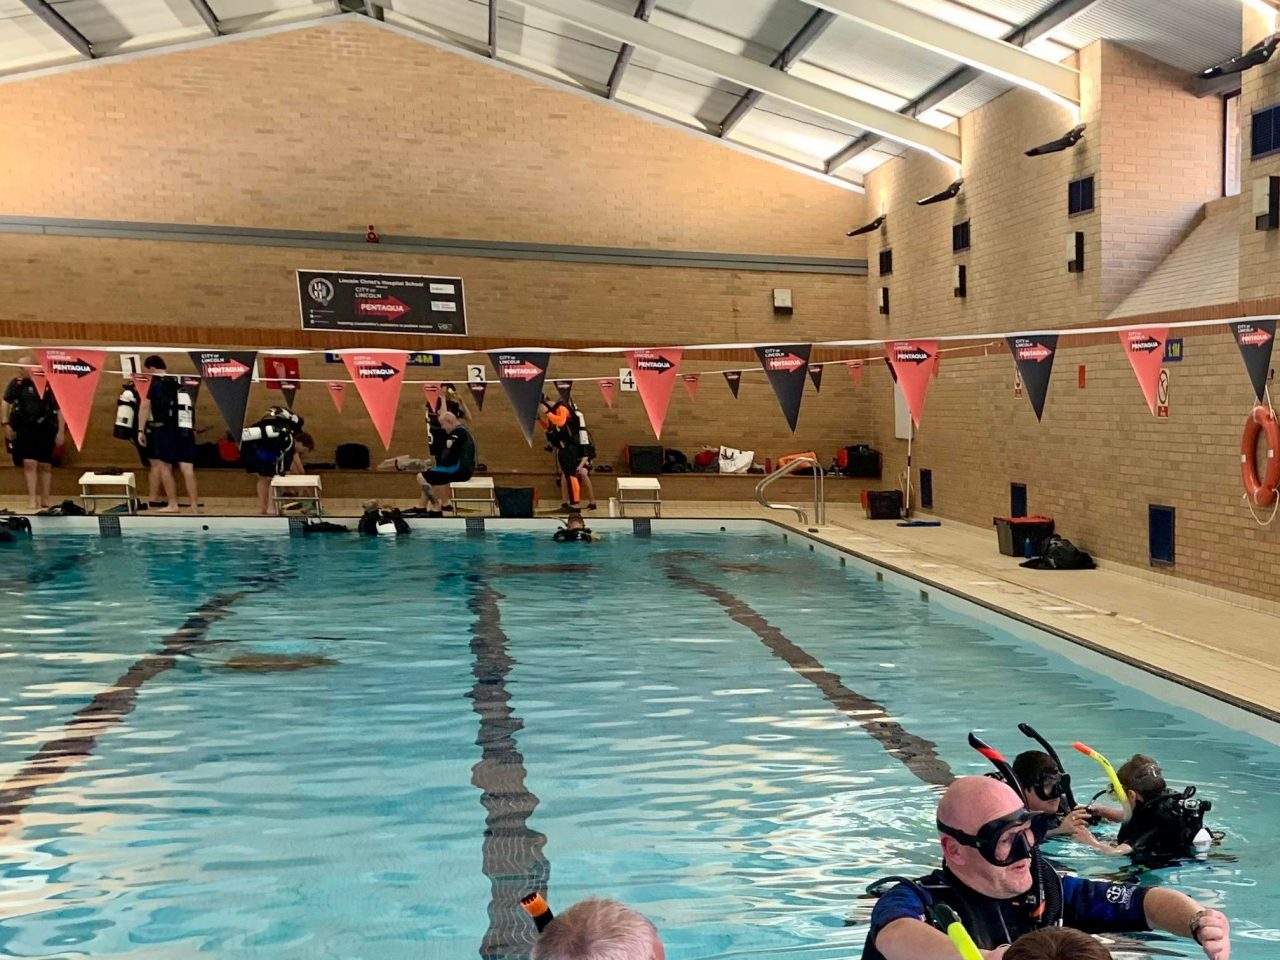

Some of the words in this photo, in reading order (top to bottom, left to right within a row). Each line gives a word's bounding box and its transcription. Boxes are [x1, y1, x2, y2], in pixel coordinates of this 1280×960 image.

[361, 303, 404, 312] PENTAQUA
[53, 364, 91, 372] PENTAQUA
[208, 366, 246, 374] PENTAQUA
[471, 367, 484, 382] 3
[622, 370, 635, 389] 4
